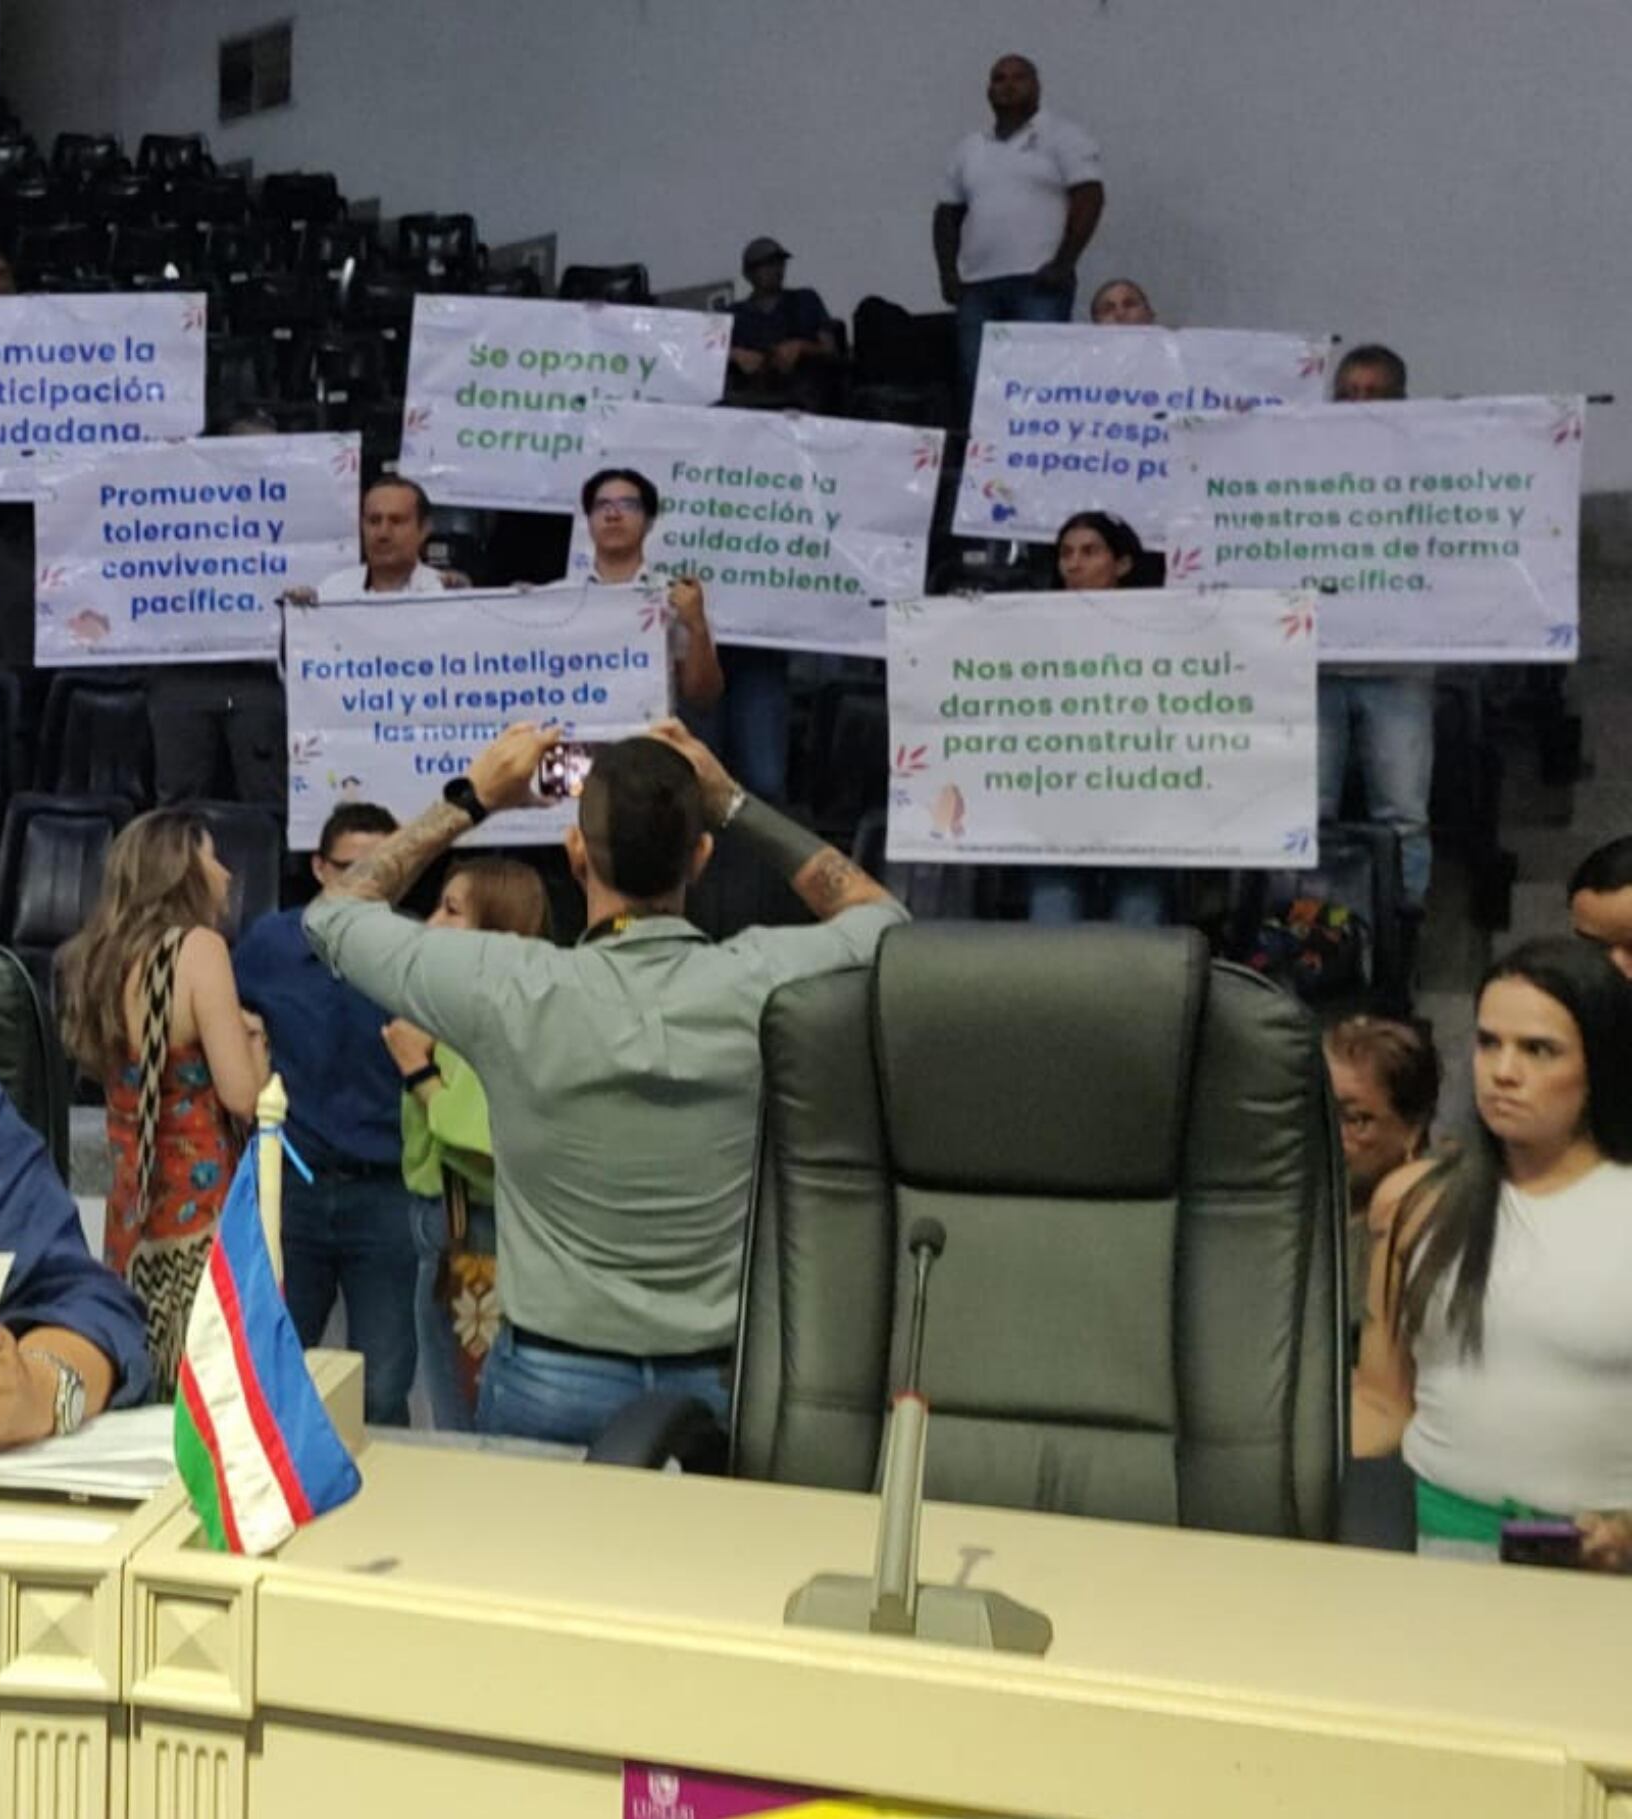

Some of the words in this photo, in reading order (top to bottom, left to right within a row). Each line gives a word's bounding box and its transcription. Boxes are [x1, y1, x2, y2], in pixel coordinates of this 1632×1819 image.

[125, 336, 154, 362] la
[469, 344, 509, 367] Se
[519, 348, 629, 375] opone
[638, 355, 658, 382] y
[456, 381, 623, 413] denunc
[1005, 381, 1160, 407] Promueve
[1009, 418, 1060, 436] uso
[1068, 420, 1085, 441] y
[672, 461, 803, 490] Fortalece
[1007, 451, 1130, 476] espacio
[100, 483, 252, 506] Promueve
[260, 478, 286, 500] la
[1207, 477, 1259, 498] Nos
[1265, 473, 1375, 496] enseña
[1383, 476, 1402, 493] a
[1409, 469, 1536, 493] resolver
[104, 514, 260, 543] tolerancia
[268, 519, 284, 543] y
[825, 510, 841, 531] y
[1215, 505, 1341, 528] nuestros
[1348, 503, 1499, 527] conflictos
[1509, 506, 1525, 527] y
[663, 525, 780, 556] cuidado
[787, 536, 830, 558] del
[1215, 540, 1375, 565] problemas
[1383, 538, 1420, 557] de
[1427, 536, 1519, 557] forma
[102, 551, 286, 579] convivencia
[721, 566, 866, 595] ambiente.
[131, 587, 264, 619] pacífica.
[302, 655, 434, 680] Fortalece
[441, 654, 466, 675] la
[474, 646, 649, 678] inteligencia
[952, 658, 1013, 680] Nos
[1021, 652, 1143, 678] enseña
[1152, 659, 1172, 676] a
[1181, 651, 1246, 676] cui-
[343, 689, 392, 712] vial
[402, 693, 416, 714] y
[424, 688, 447, 707] el
[455, 686, 564, 711] respeto
[573, 683, 608, 703] de
[940, 694, 1052, 719] darnos
[1061, 694, 1148, 716] entre
[1157, 690, 1254, 714] todos
[375, 721, 414, 743] las
[423, 722, 508, 741] norm
[943, 731, 1017, 759] para
[1026, 727, 1176, 753] construir
[1186, 730, 1250, 751] una
[414, 753, 472, 774] trán
[984, 767, 1076, 797] mejor
[1085, 765, 1212, 790] ciudad.
